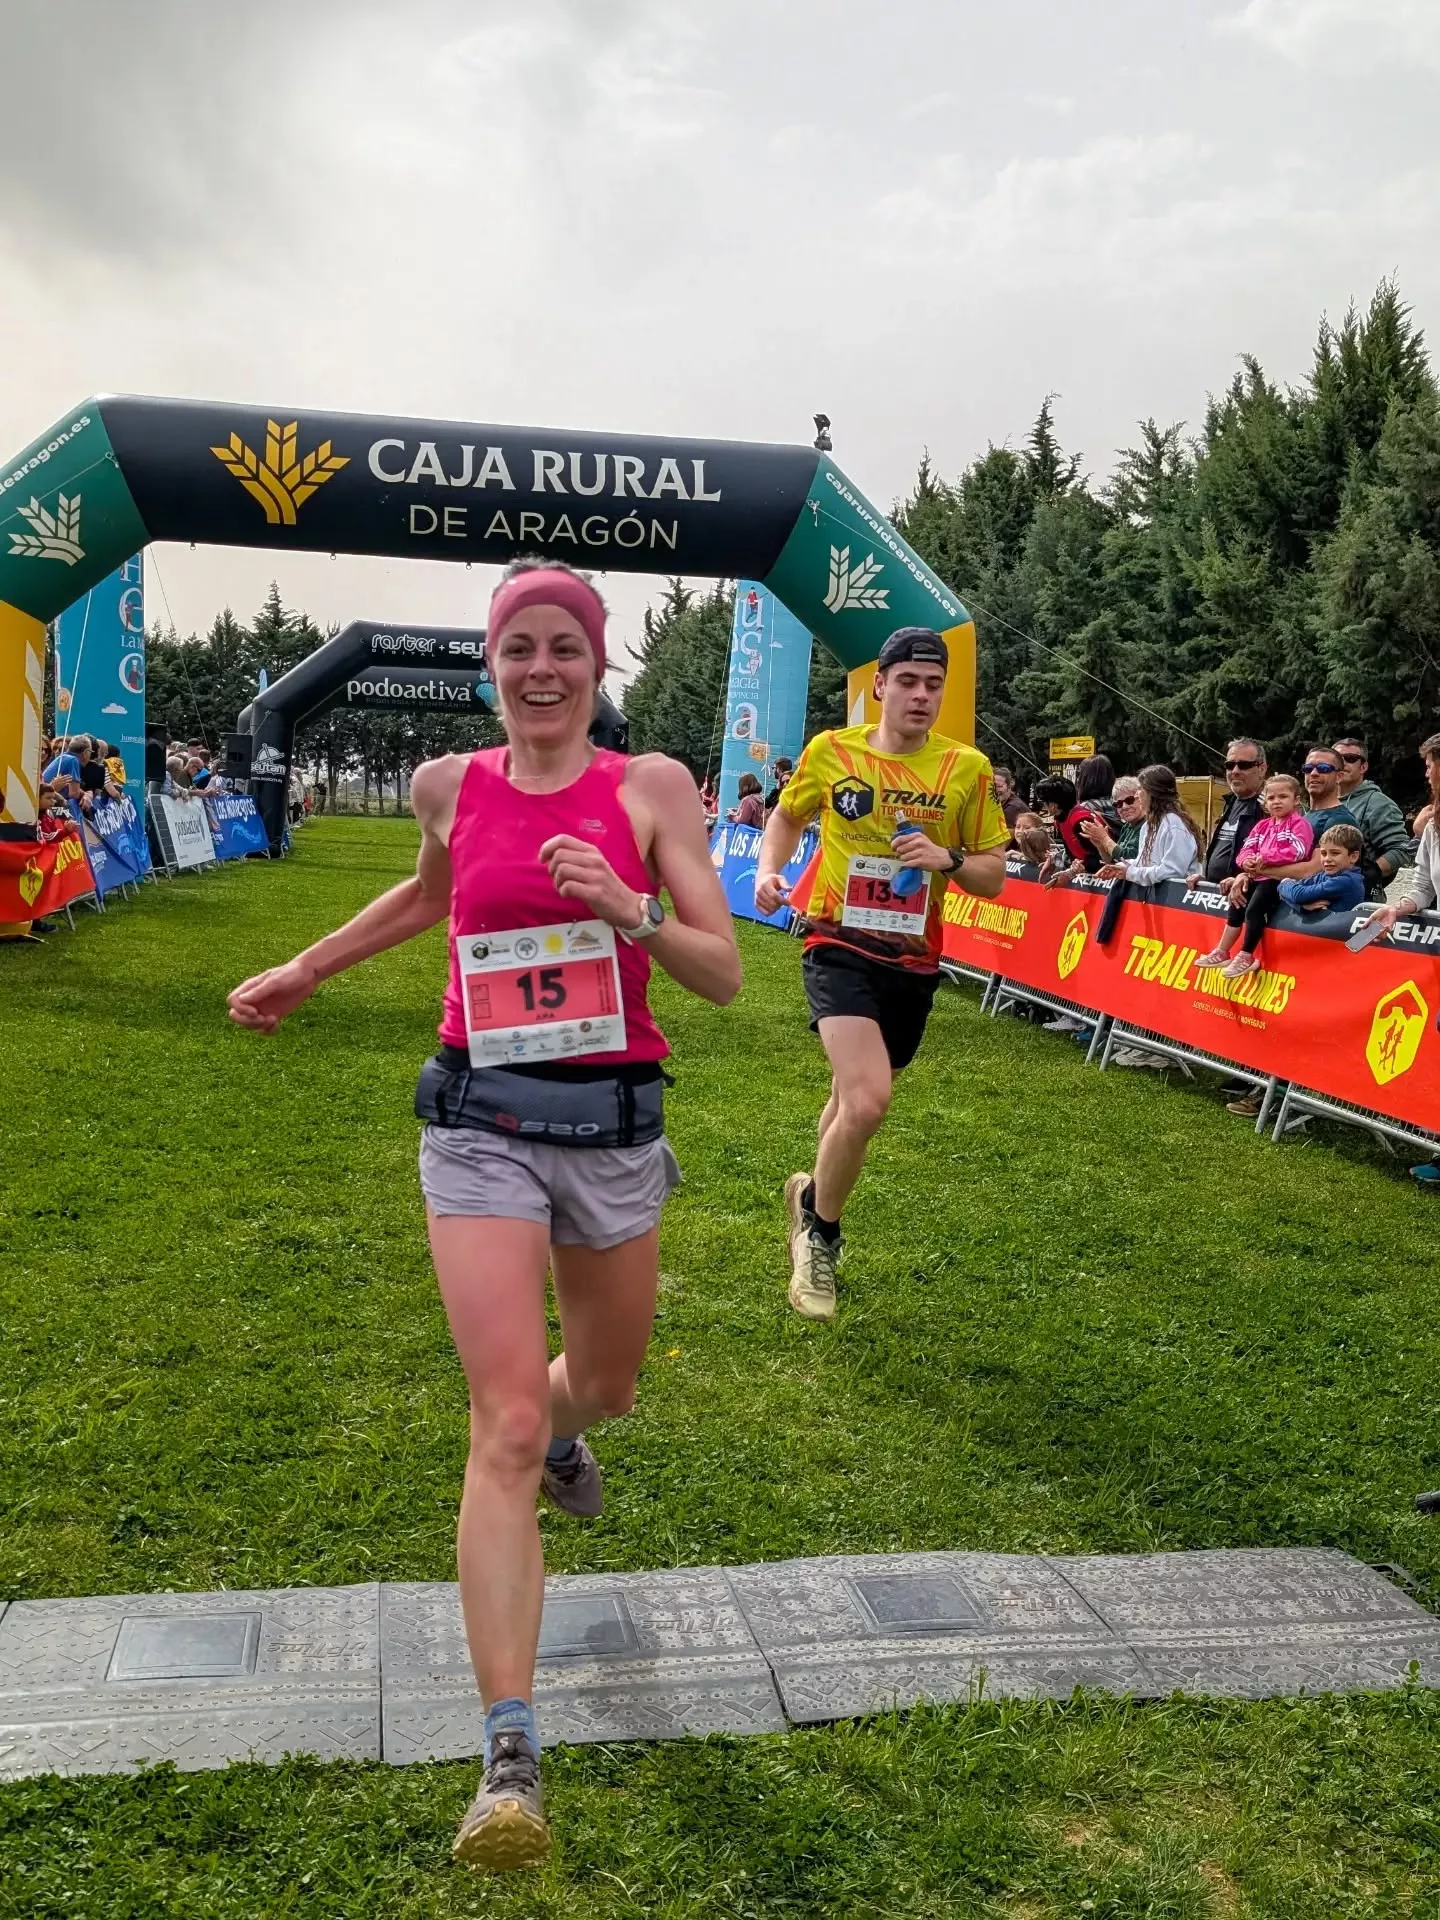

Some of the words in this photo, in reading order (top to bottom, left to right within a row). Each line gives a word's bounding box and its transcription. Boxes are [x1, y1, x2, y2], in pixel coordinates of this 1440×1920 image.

[368, 438, 516, 491] CAJA
[531, 449, 722, 502] RURAL
[409, 504, 468, 538] DE
[484, 509, 679, 550] ARAGÓN
[824, 471, 958, 618] cajaruraldearagon.es
[371, 633, 437, 653] raster
[347, 677, 472, 702] podoactiva
[881, 788, 947, 810] TRAIL
[1124, 935, 1198, 992] TRAIL
[516, 967, 567, 1012] 15
